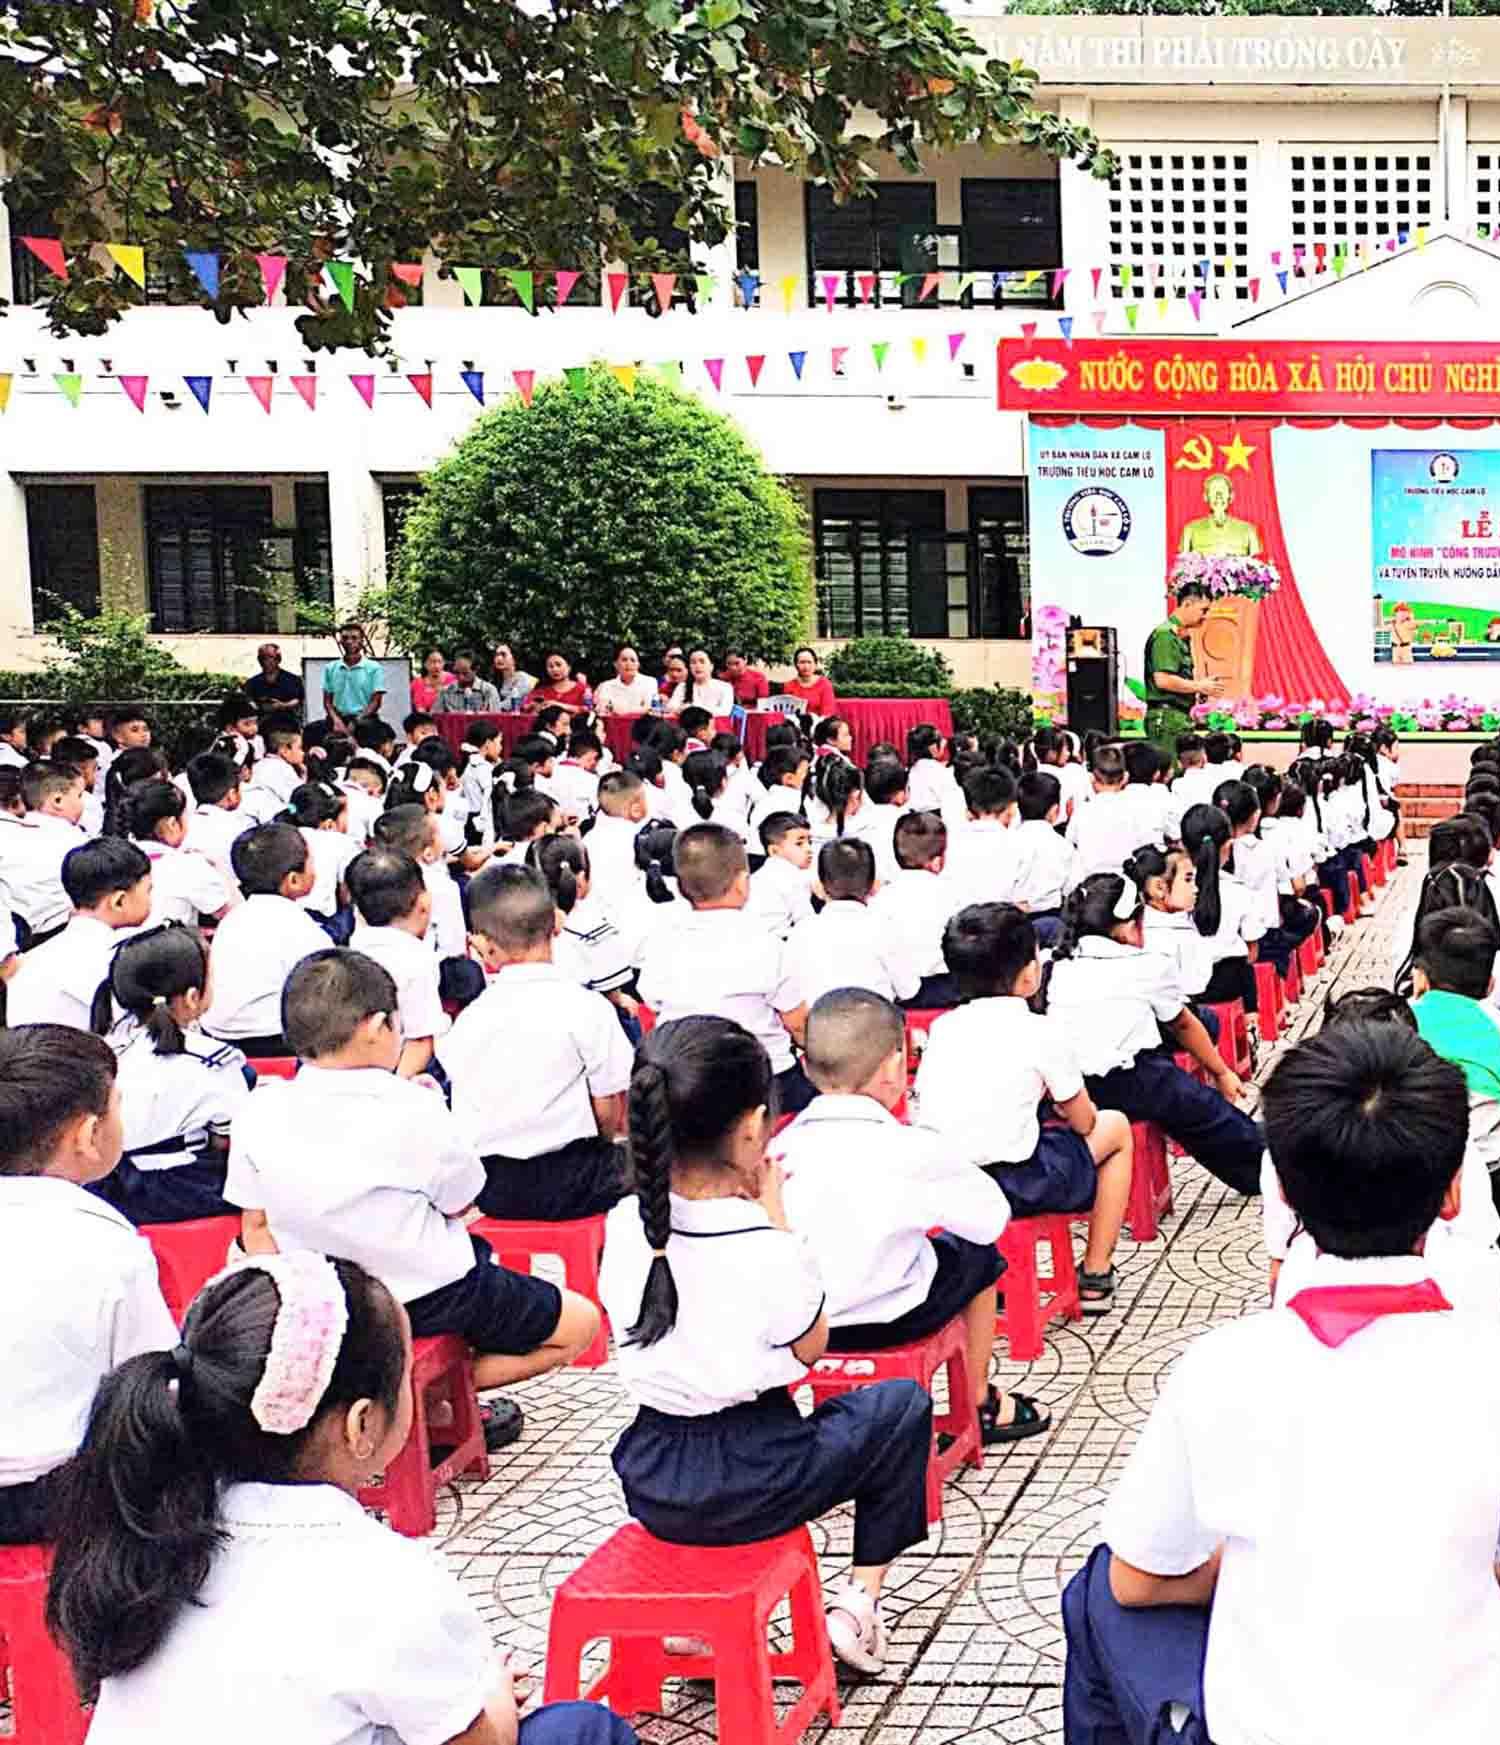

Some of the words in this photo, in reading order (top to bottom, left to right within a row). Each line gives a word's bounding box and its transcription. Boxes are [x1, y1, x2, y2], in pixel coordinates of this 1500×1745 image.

[1347, 28, 1408, 69] CÂY
[1079, 350, 1145, 392] NƯỚC
[1153, 353, 1218, 400] CỘNG
[1228, 352, 1280, 392] HÒA
[1287, 353, 1325, 392] XÃ
[1336, 353, 1377, 400] HỘI
[1384, 351, 1434, 393] CHỦ
[1461, 510, 1492, 538] LỄ
